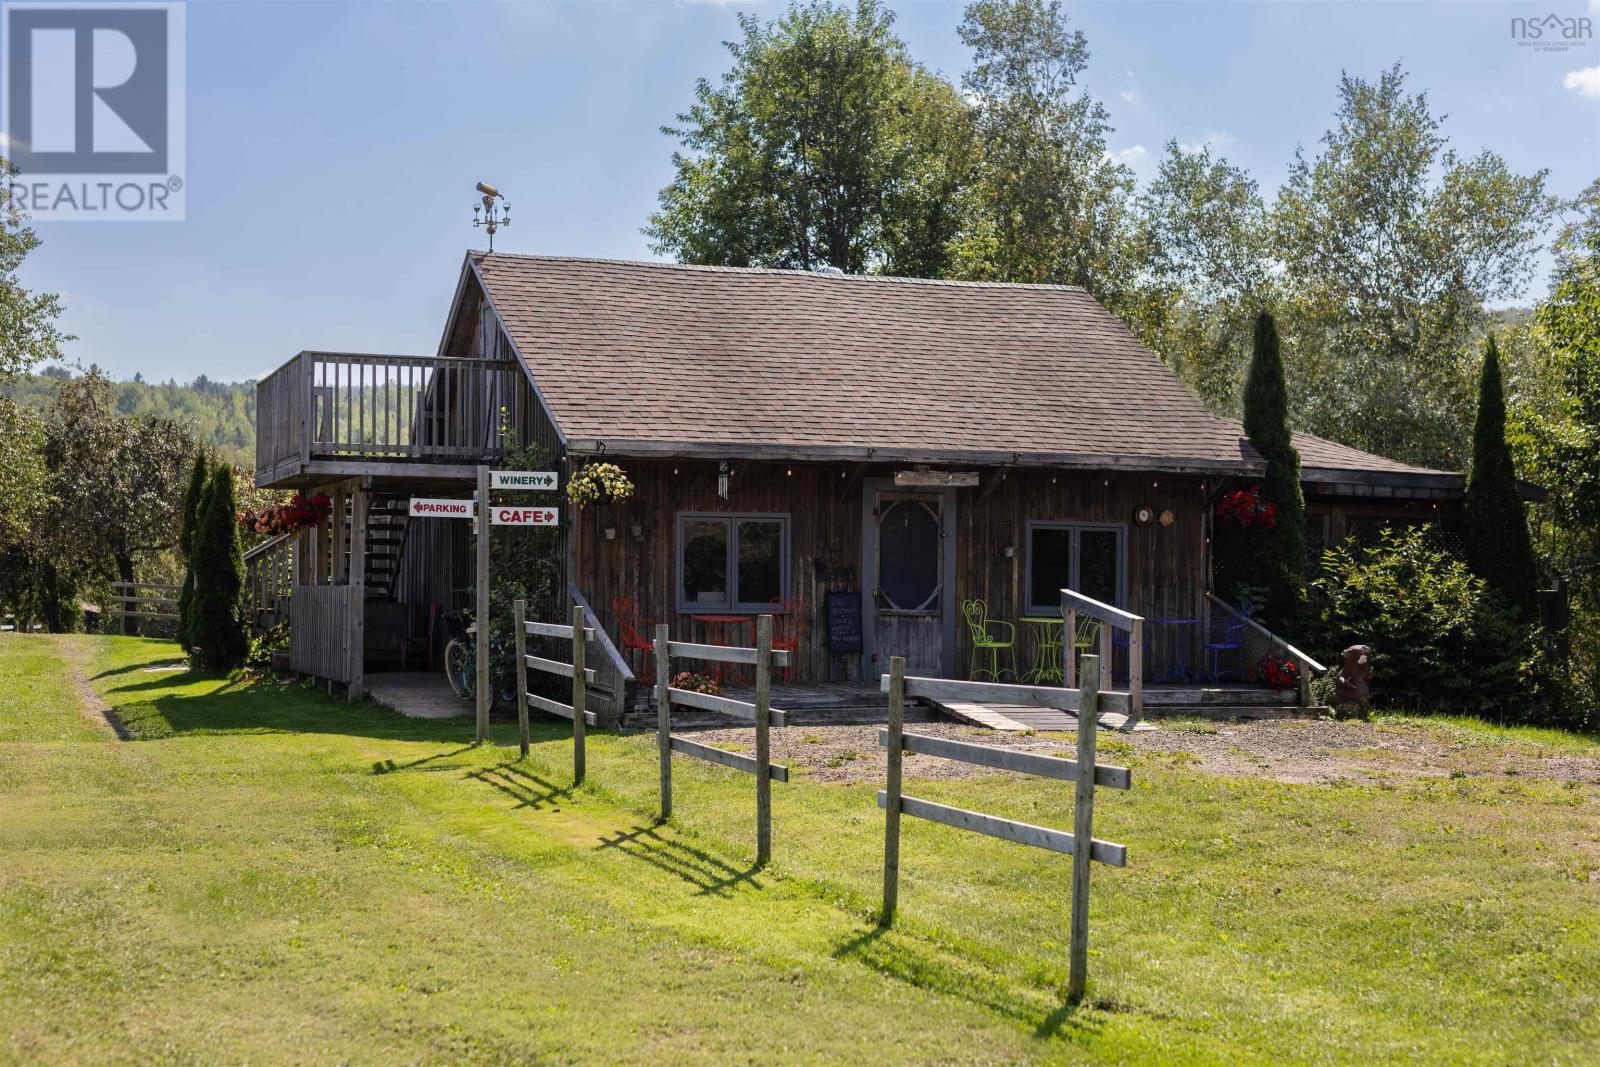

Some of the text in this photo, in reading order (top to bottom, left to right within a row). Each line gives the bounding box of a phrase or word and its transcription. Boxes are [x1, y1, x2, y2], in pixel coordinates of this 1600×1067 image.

[500, 476, 543, 485] WINERY
[423, 503, 467, 513] PARKING
[500, 510, 543, 523] CAFE
